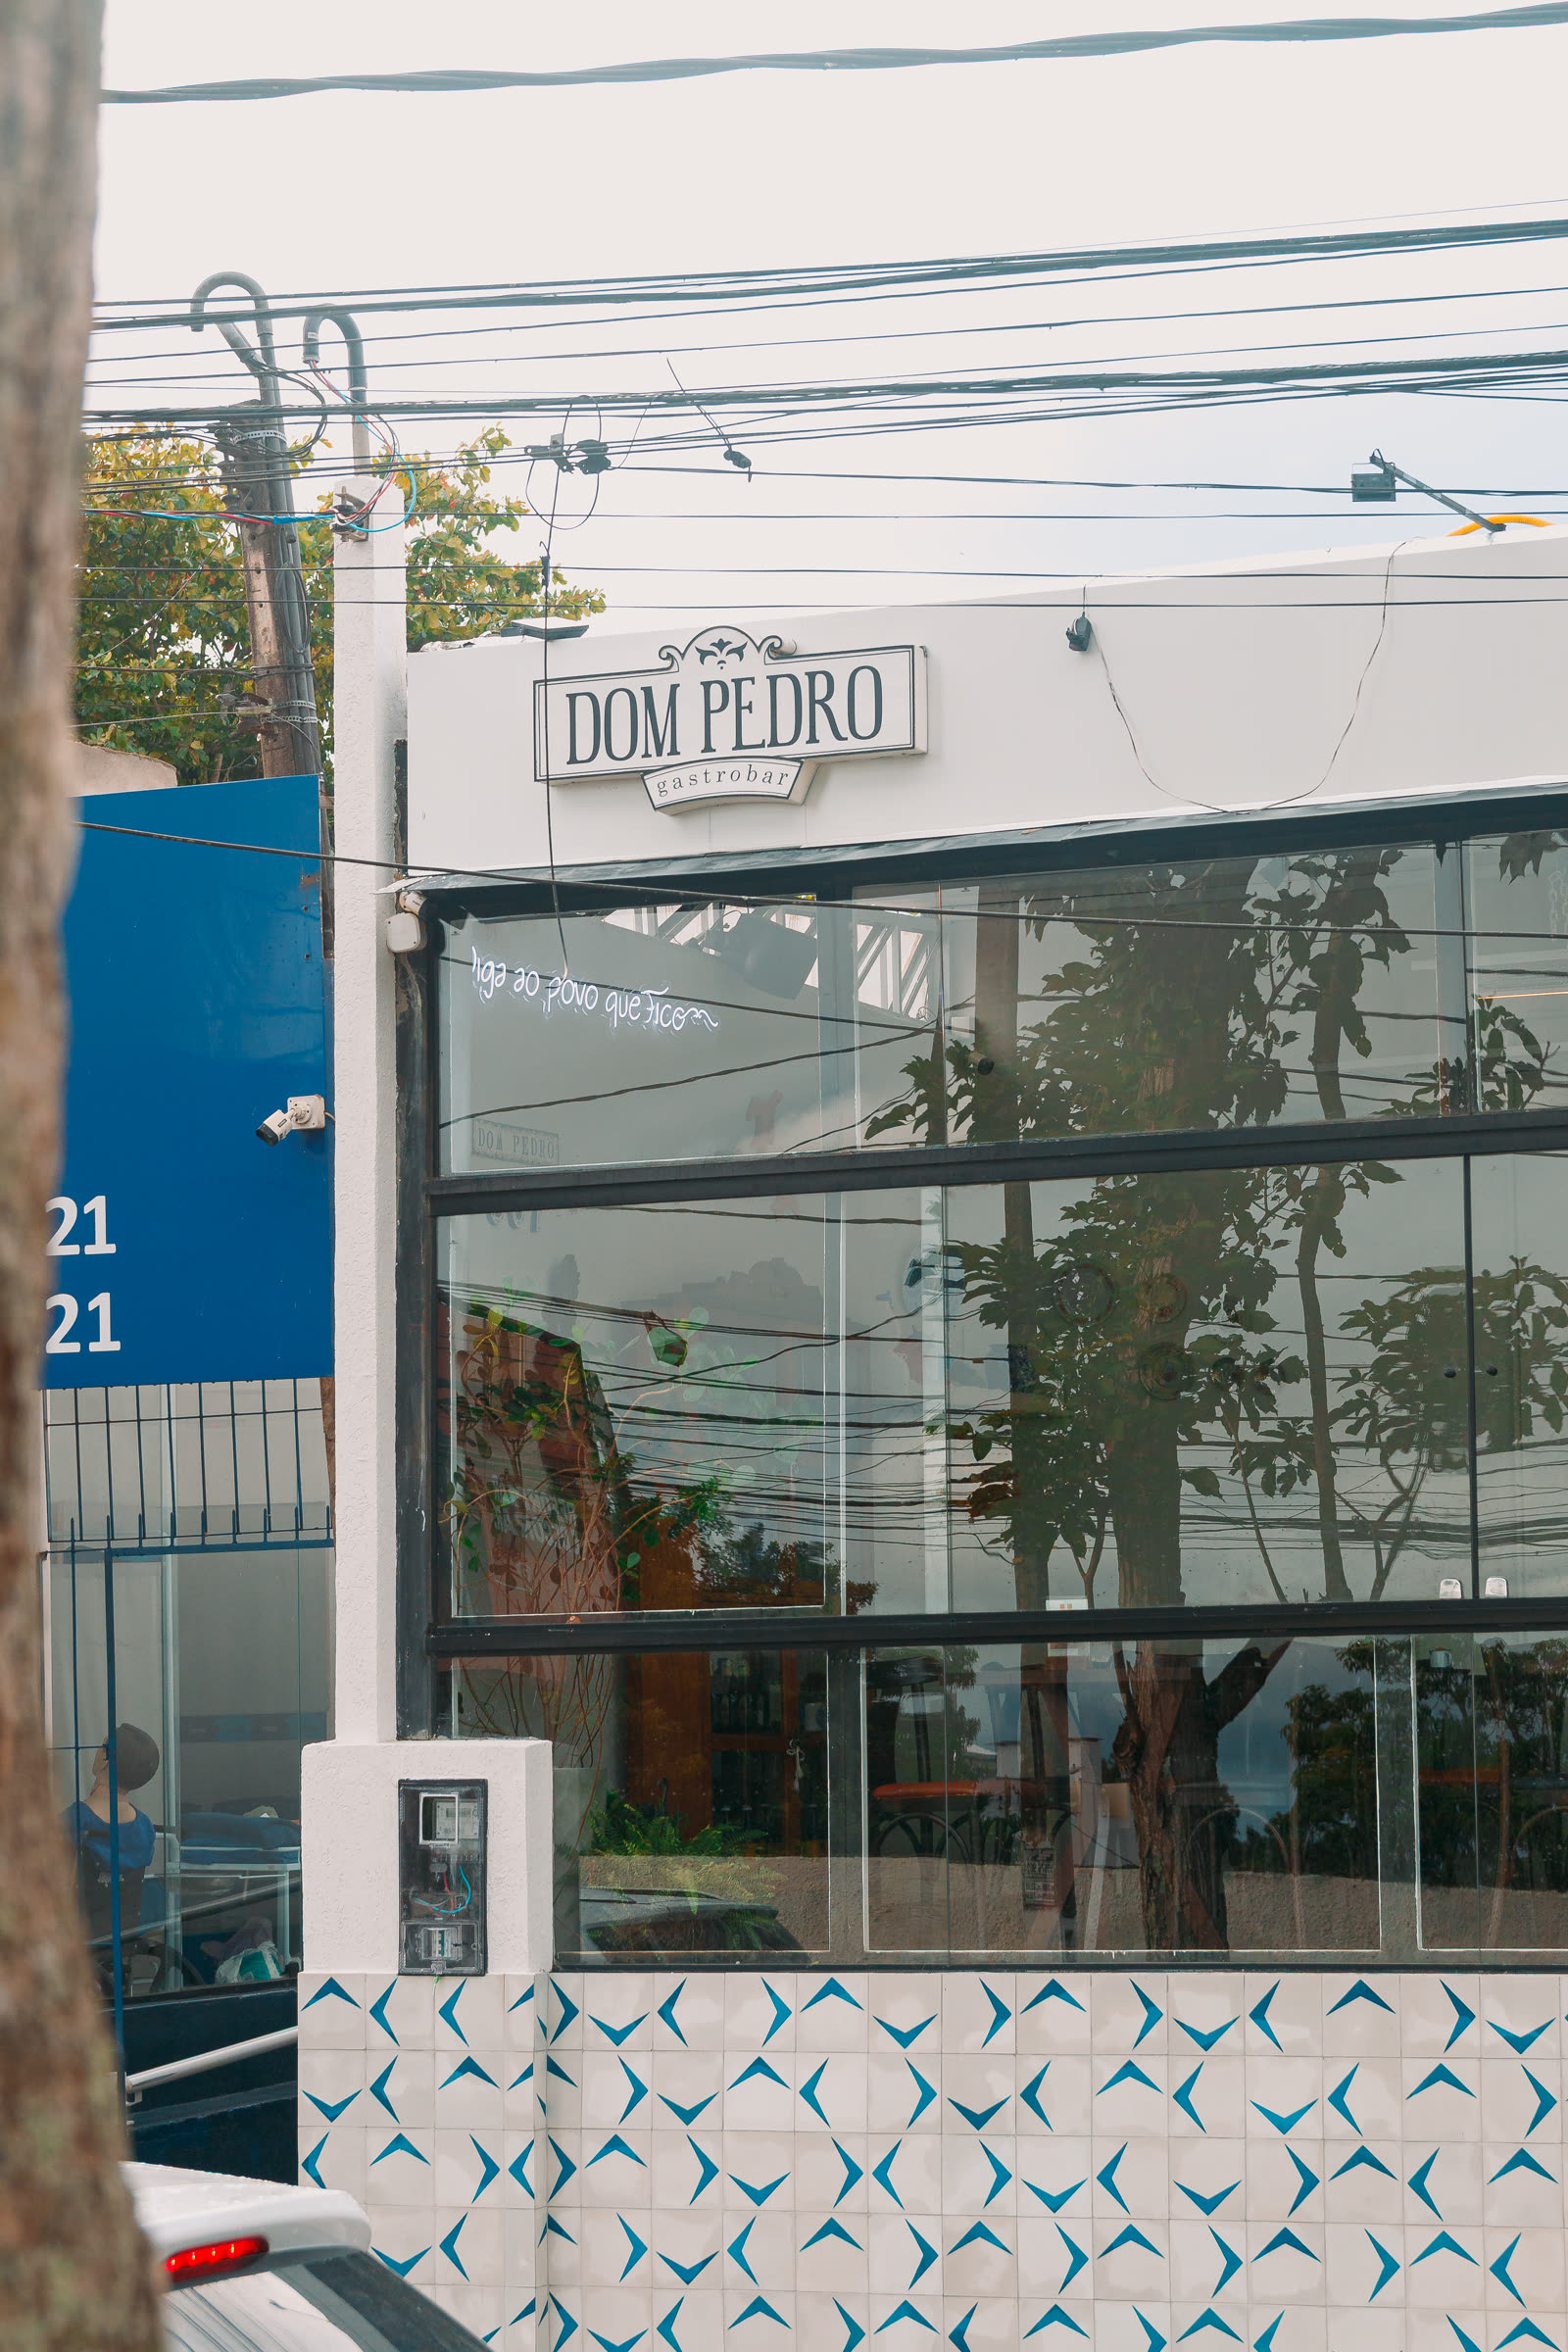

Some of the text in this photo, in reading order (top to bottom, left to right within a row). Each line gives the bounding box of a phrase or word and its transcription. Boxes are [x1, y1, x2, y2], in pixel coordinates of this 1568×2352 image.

[565, 664, 884, 765] DOM PEDRO
[656, 763, 791, 798] gastrobar
[514, 967, 540, 997] ao
[547, 976, 599, 1013] povo
[605, 991, 641, 1028] que
[513, 1134, 555, 1160] PEDRO
